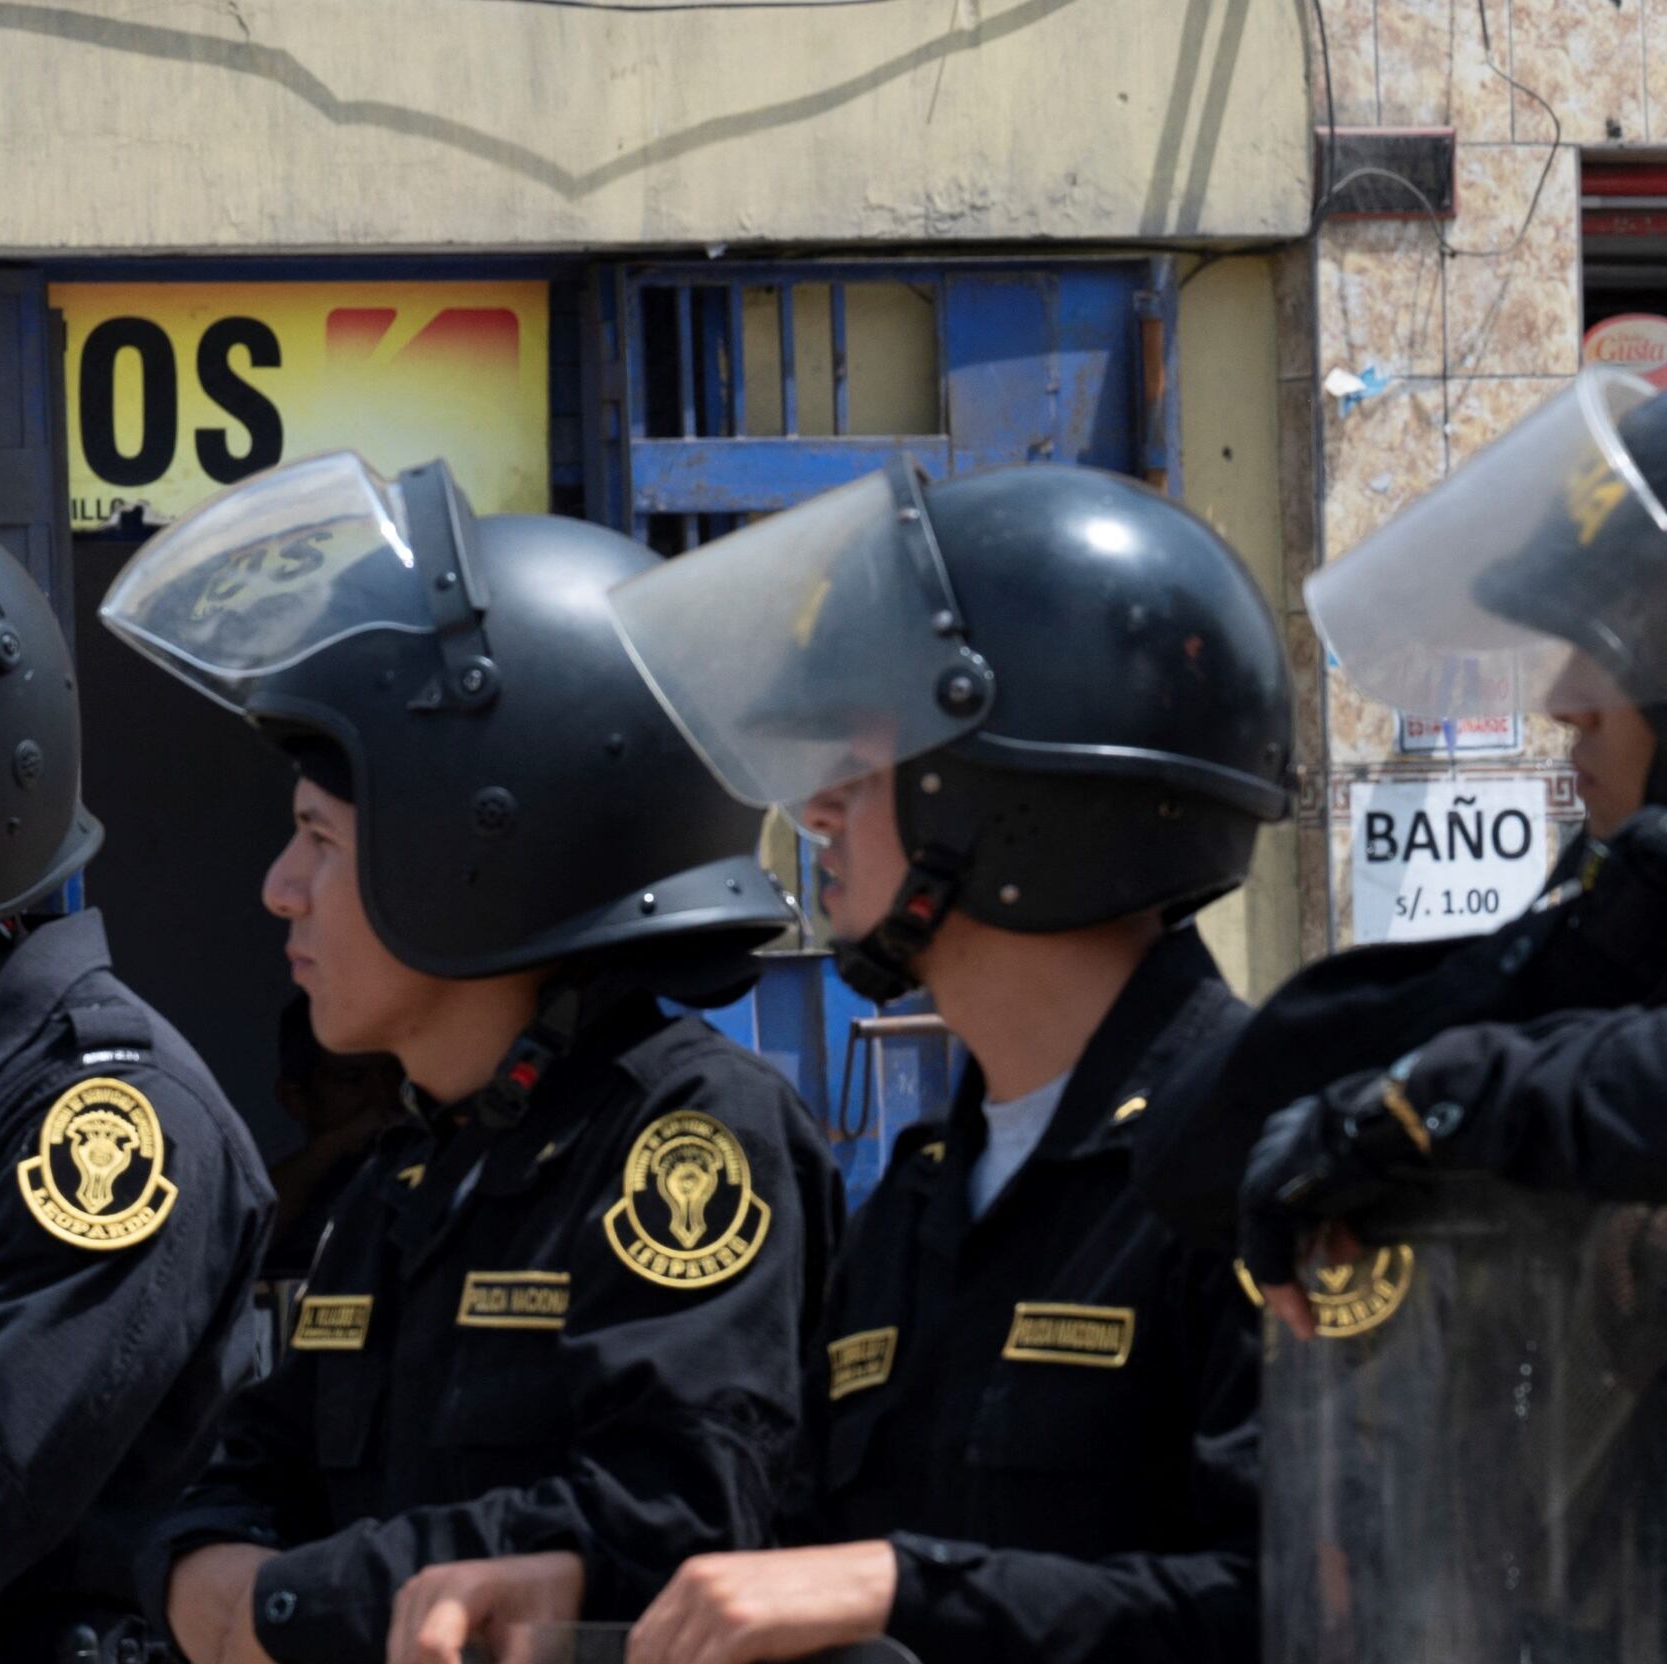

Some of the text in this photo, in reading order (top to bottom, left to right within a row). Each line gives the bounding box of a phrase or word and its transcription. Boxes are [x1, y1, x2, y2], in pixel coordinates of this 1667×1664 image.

[1366, 795, 1533, 865] BAÑO
[1442, 888, 1500, 915] 1.00
[32, 1187, 156, 1240] LEOPARDO
